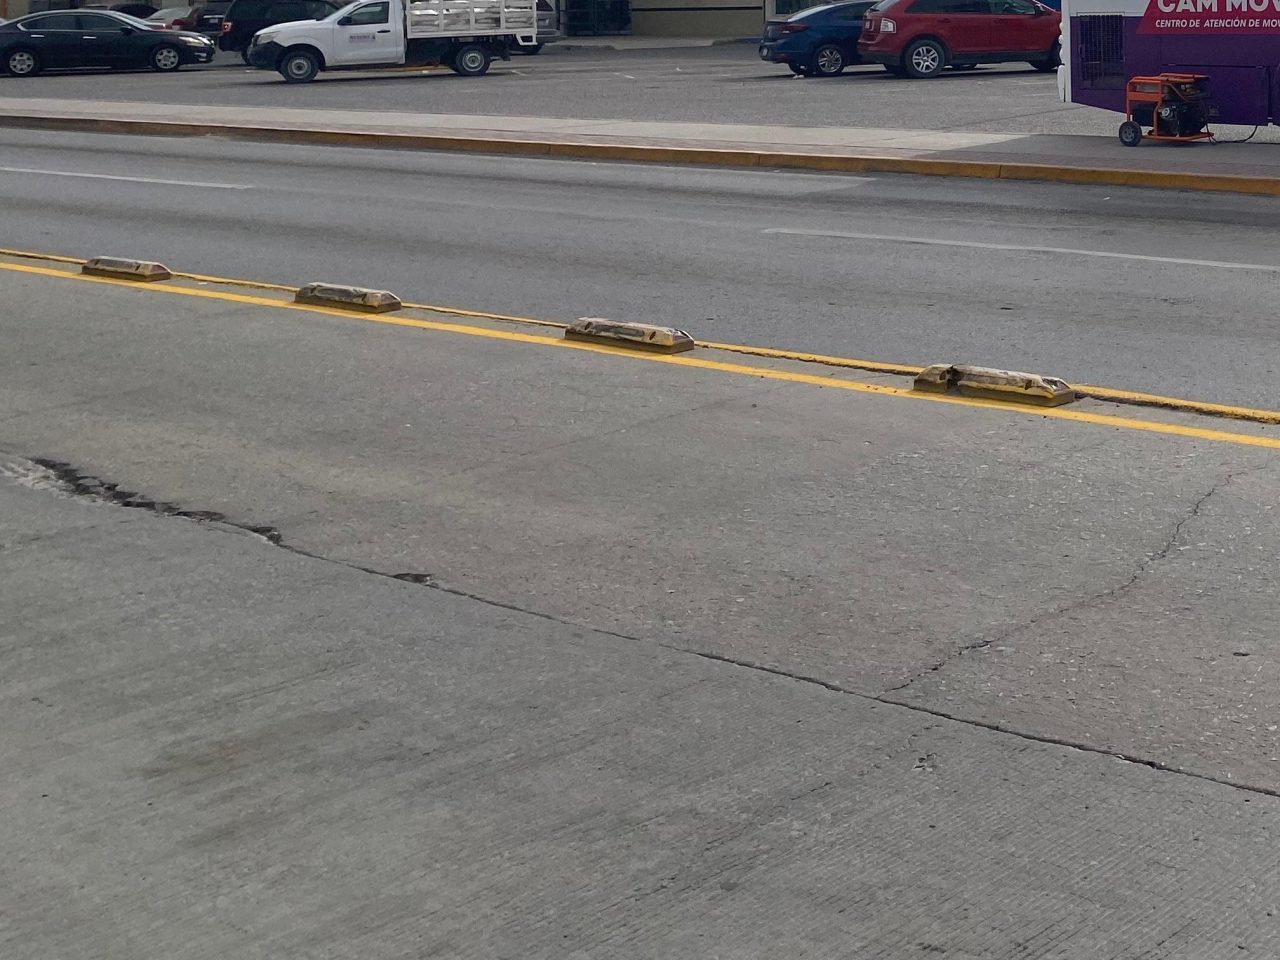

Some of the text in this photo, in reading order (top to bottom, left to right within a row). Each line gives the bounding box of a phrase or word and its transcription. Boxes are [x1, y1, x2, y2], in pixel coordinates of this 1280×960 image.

[1155, 18, 1188, 28] CENTRO
[1189, 18, 1201, 28] DE
[1203, 16, 1247, 28] ATENCIÓN
[1248, 18, 1260, 28] DE
